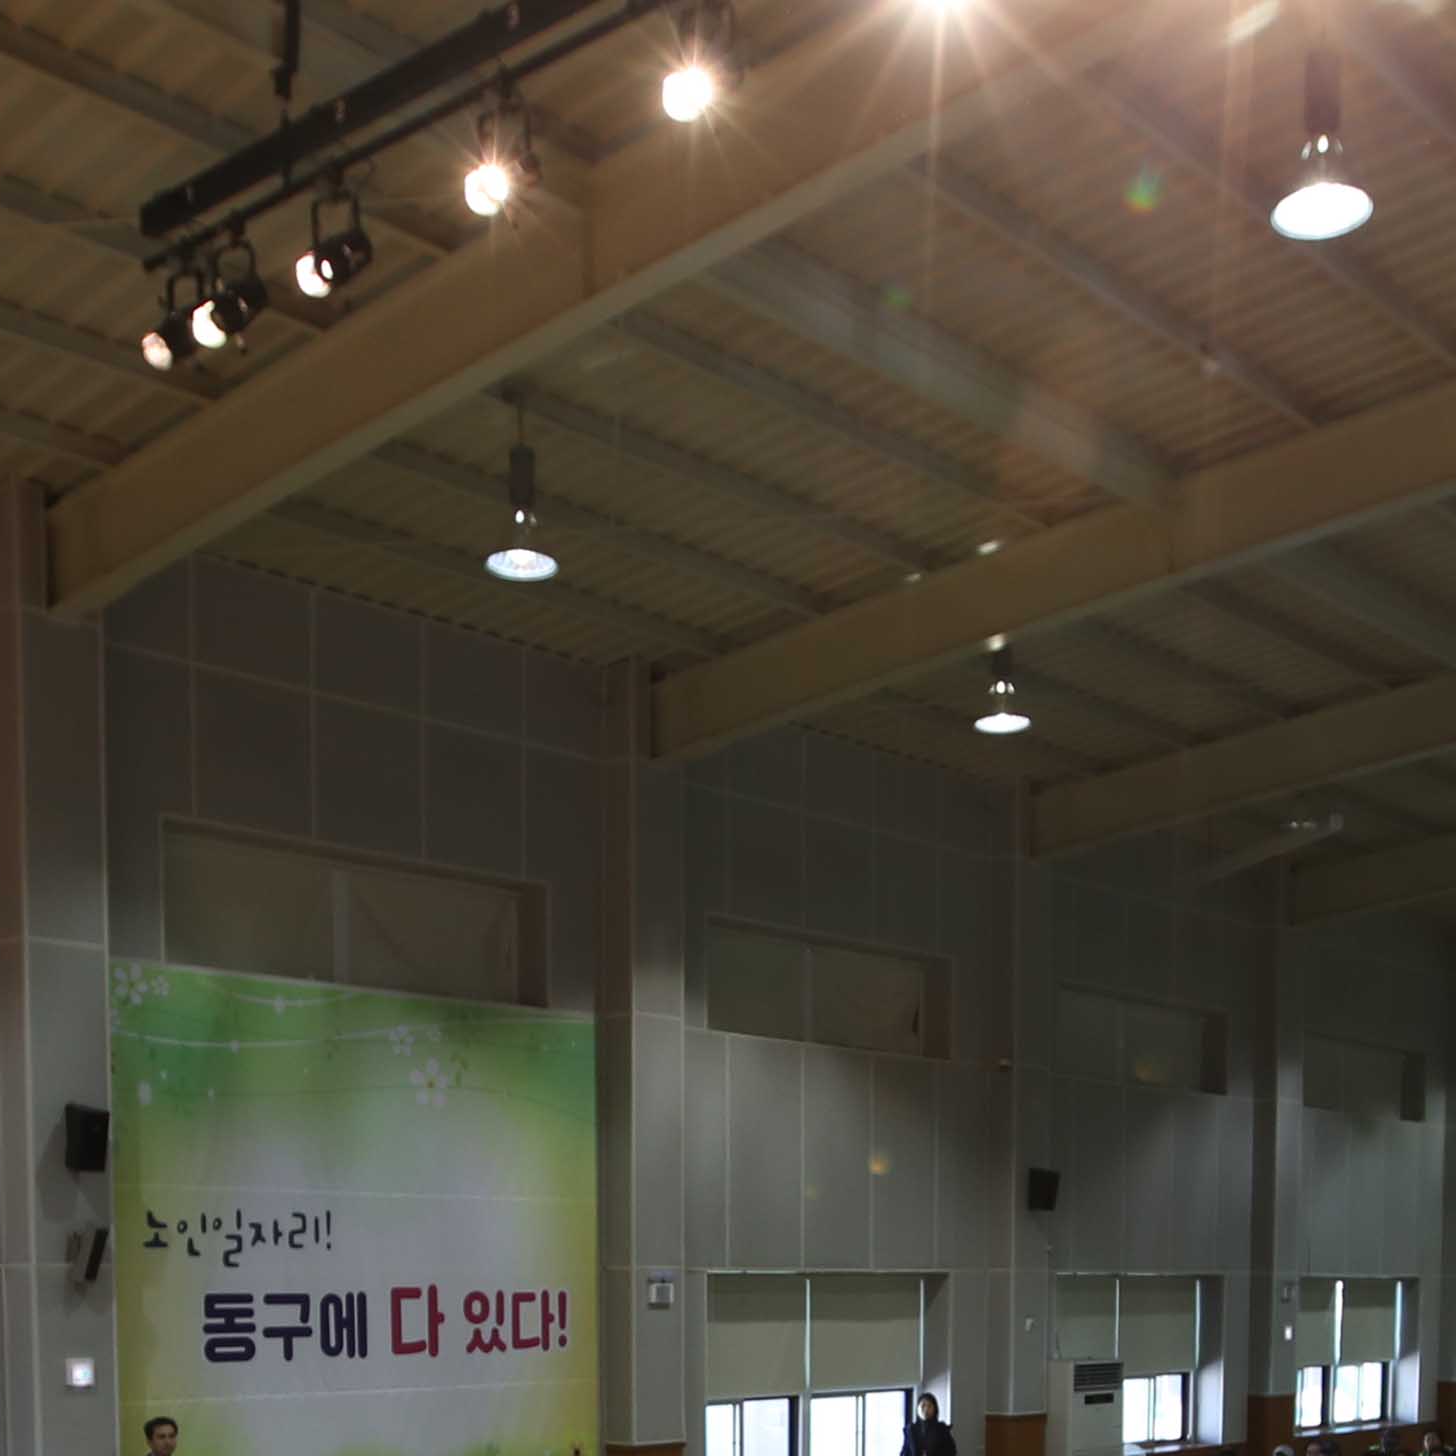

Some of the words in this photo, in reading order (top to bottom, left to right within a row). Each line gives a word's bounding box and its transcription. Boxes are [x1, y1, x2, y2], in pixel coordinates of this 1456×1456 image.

[202, 1291, 369, 1363] 동구에
[390, 1283, 446, 1358] 다
[463, 1289, 569, 1354] 있다!
